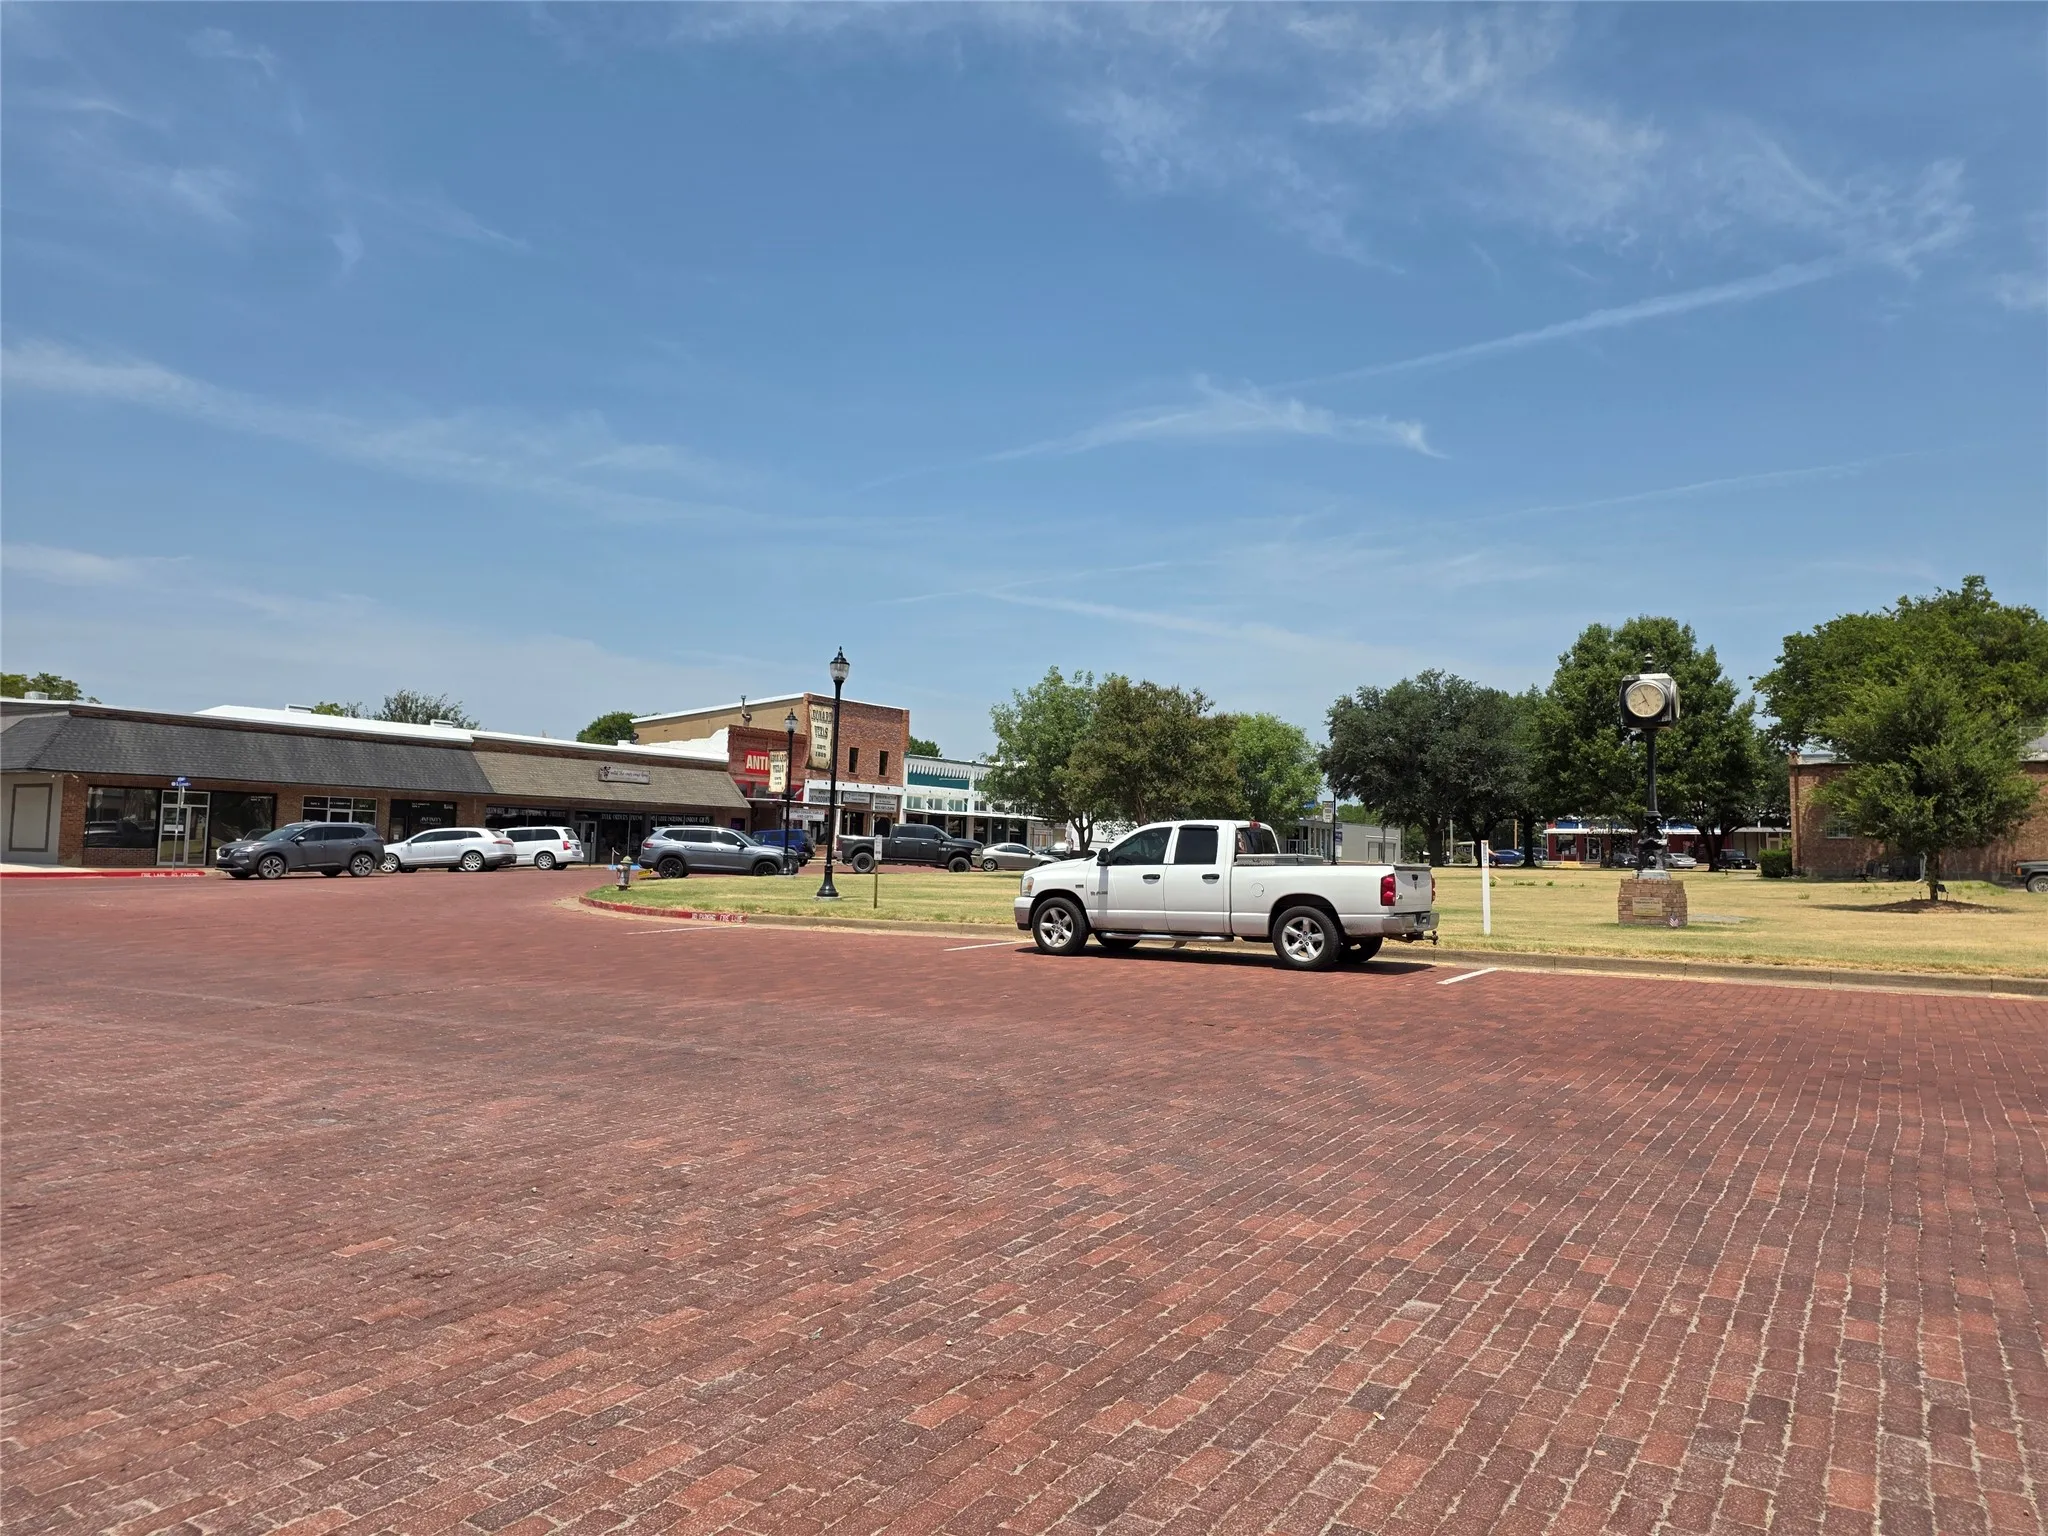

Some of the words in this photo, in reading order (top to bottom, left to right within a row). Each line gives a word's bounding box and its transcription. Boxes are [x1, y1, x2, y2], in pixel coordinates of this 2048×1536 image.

[814, 725, 829, 739] TEXAS
[746, 755, 769, 771] ANTI
[719, 913, 731, 922] FIRE
